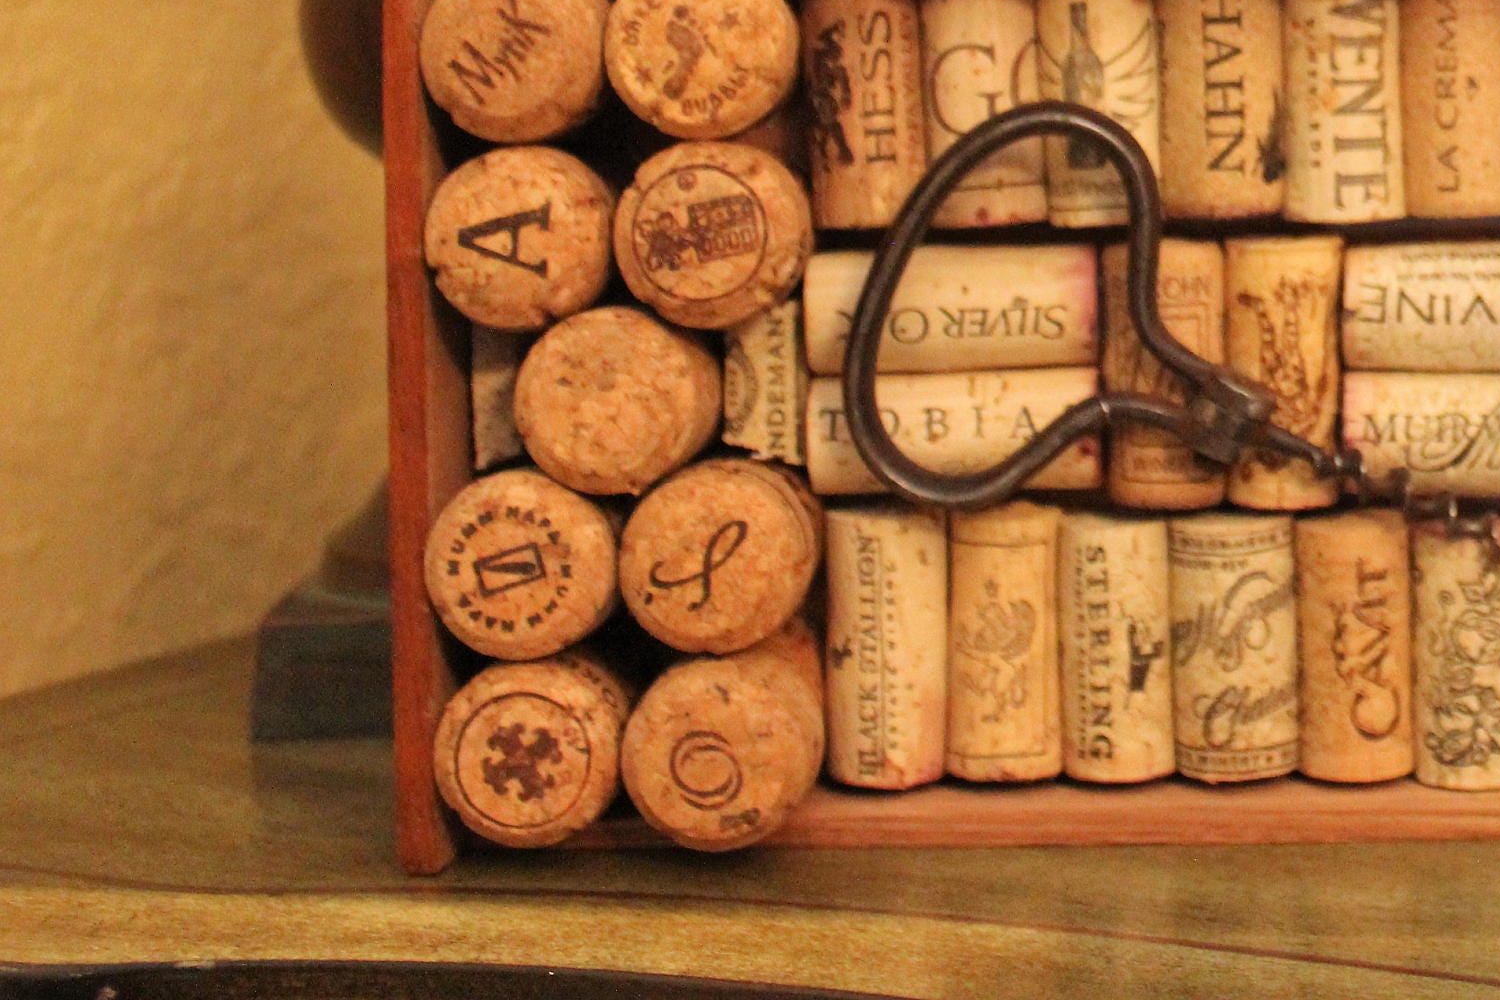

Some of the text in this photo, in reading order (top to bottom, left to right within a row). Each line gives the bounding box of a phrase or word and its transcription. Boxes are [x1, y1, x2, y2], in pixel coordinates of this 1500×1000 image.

[856, 9, 899, 164] HESS
[1436, 144, 1460, 195] LA
[457, 201, 551, 279] A
[938, 304, 1070, 342] SILVER
[446, 505, 561, 577] MUMM NAPA
[457, 563, 572, 633] MUMM NAPA
[855, 534, 883, 778] BLACK STALLION
[1084, 545, 1113, 761] STERLING
